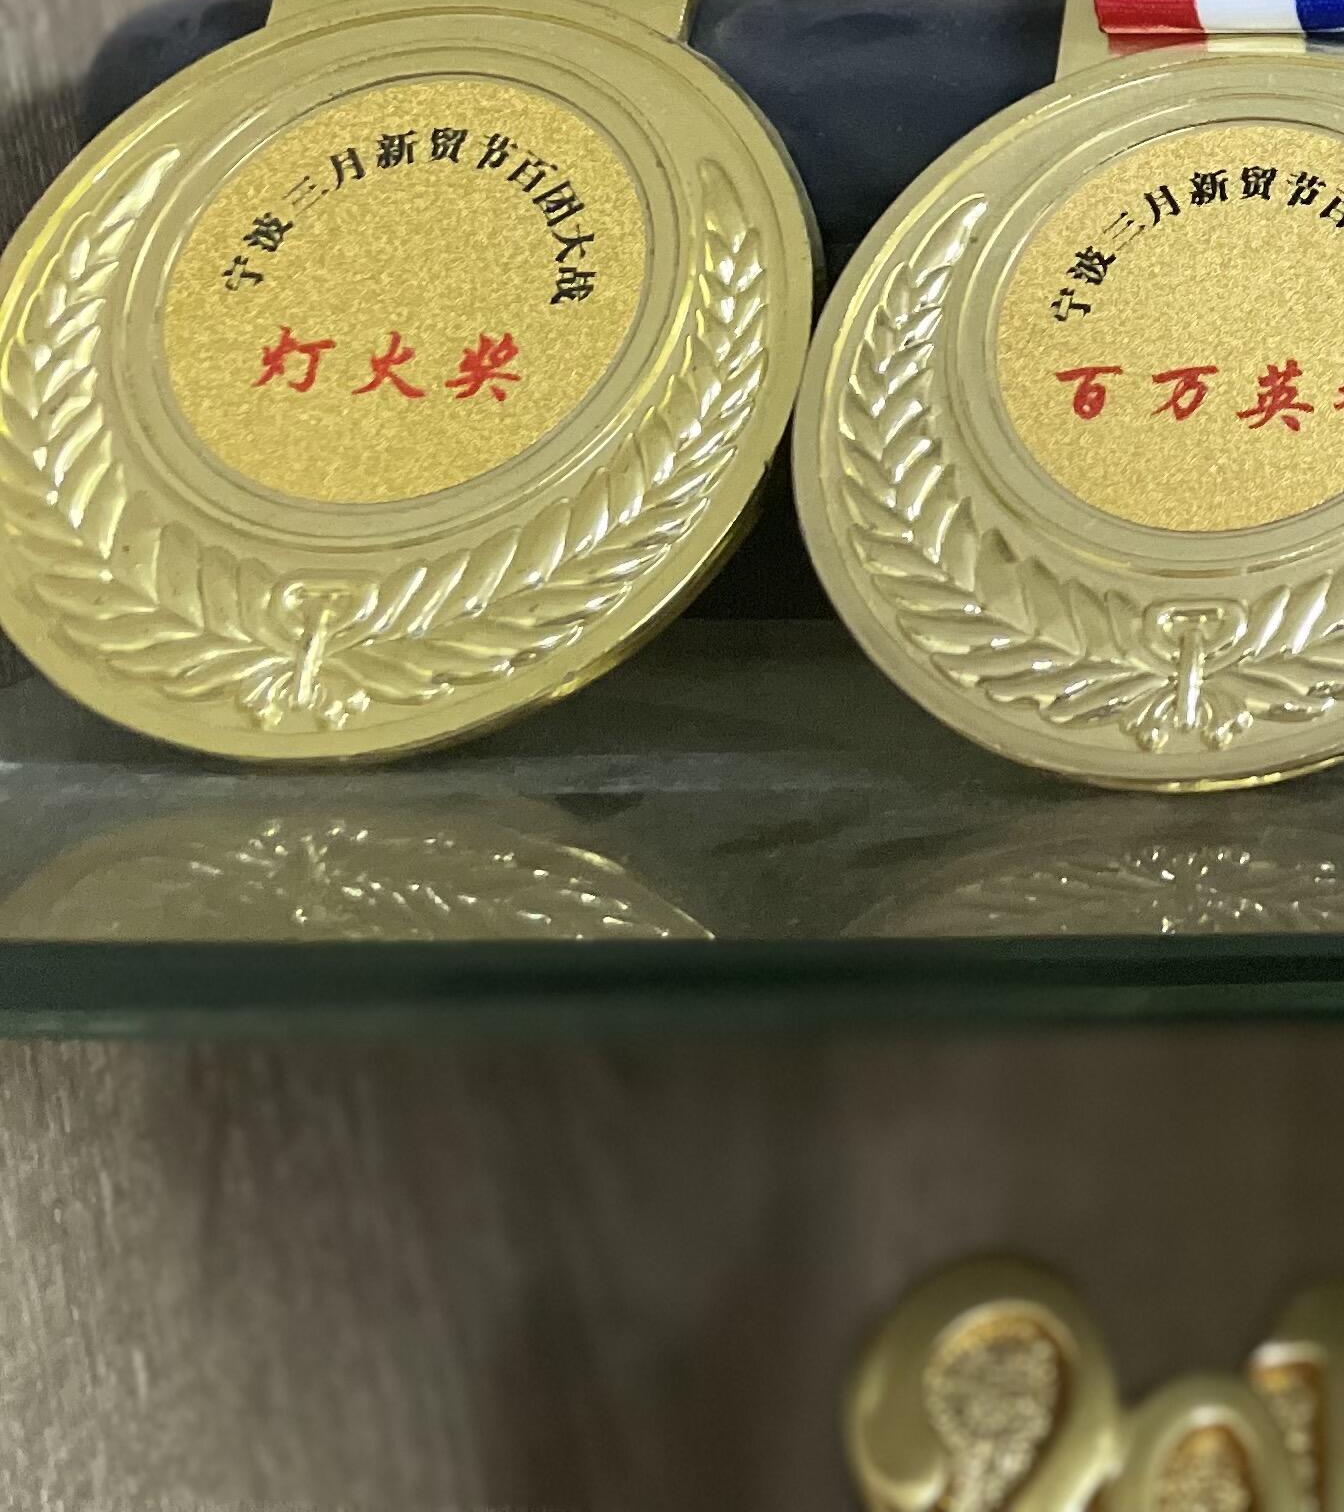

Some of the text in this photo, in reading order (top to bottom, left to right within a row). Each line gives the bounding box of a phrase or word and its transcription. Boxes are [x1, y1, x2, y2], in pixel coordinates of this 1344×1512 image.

[222, 127, 597, 305] 宁波三月新贸节百团大战
[252, 326, 521, 401] 灯火奖
